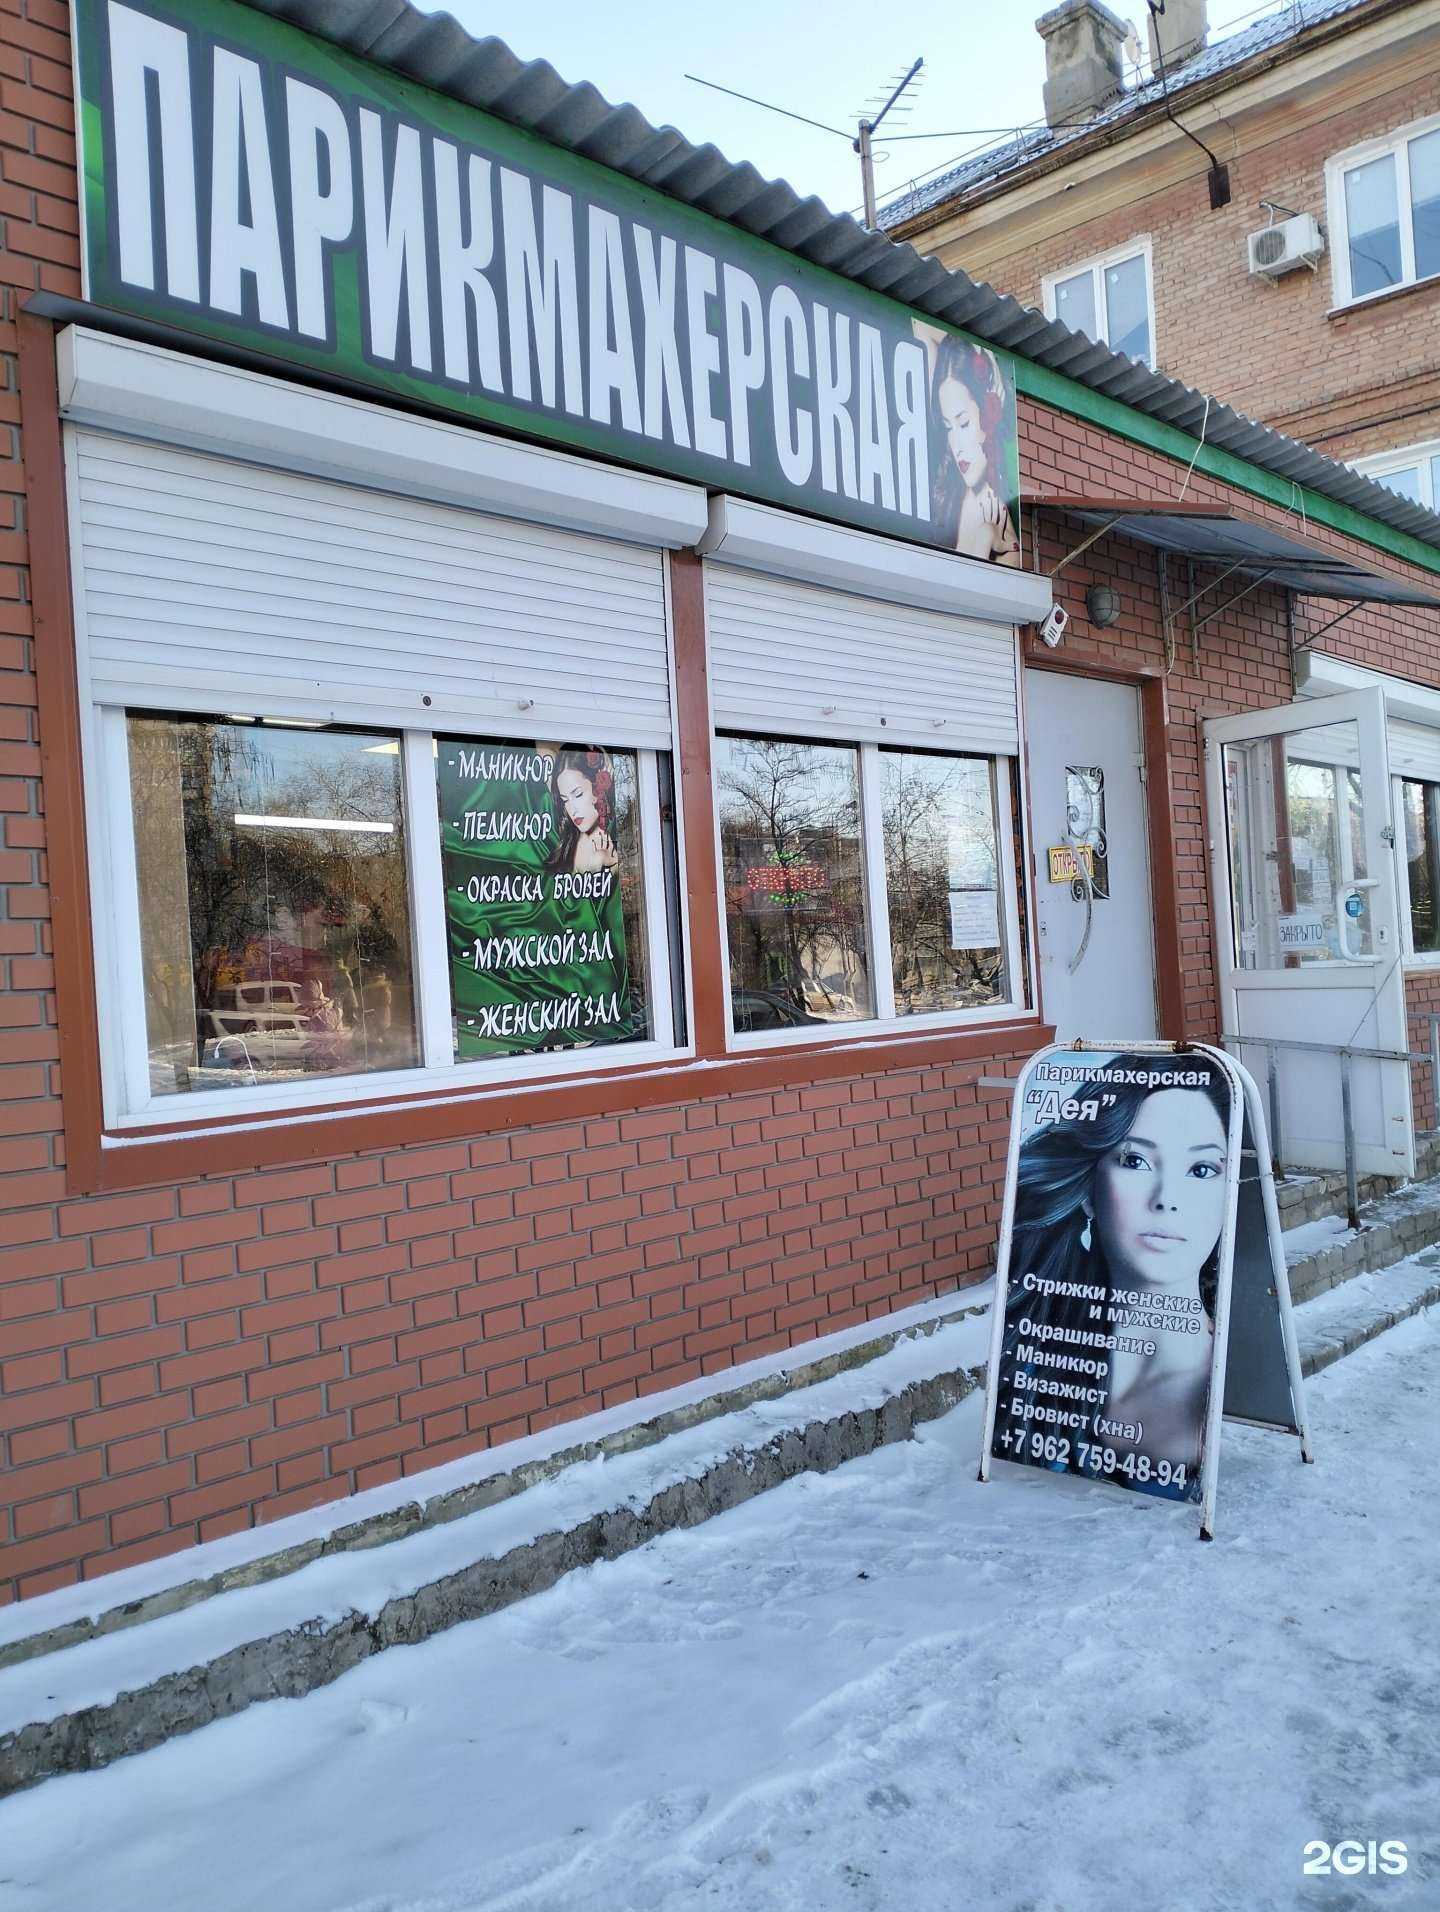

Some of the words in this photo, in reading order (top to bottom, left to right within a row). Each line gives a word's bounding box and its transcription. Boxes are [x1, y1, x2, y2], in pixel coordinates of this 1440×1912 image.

[107, 0, 932, 522] ПАРИКМАХЕРСКАЯ
[458, 750, 553, 784] МАНИКЮР
[462, 811, 552, 841] ПЕДИКЮР
[1053, 851, 1090, 875] ОТКРТО
[467, 874, 544, 903] ОКРАСКА
[553, 868, 613, 900] БРОВЕЙ
[473, 929, 576, 970] МУЖСКОЙ
[578, 929, 615, 963] ЗАЛ
[1279, 923, 1323, 943] ЗАКРЫТО
[478, 992, 580, 1038] ЖЕНСКИЙ
[584, 991, 621, 1026] ЗАЛ
[1036, 1062, 1211, 1088] Парикмахерская
[1023, 1273, 1106, 1301] Стрижки
[1110, 1287, 1202, 1315] женские
[1018, 1317, 1156, 1357] Окрашивание
[1089, 1304, 1102, 1321] и
[1107, 1308, 1201, 1335] мужские
[1016, 1344, 1109, 1379] Маникюр
[1014, 1370, 1108, 1405] Визажист
[1011, 1397, 1090, 1430] Бровист
[1093, 1414, 1143, 1444] (хна)
[1001, 1428, 1027, 1454] +7
[1031, 1432, 1071, 1464] 962
[1077, 1441, 1187, 1491] 759-48-94
